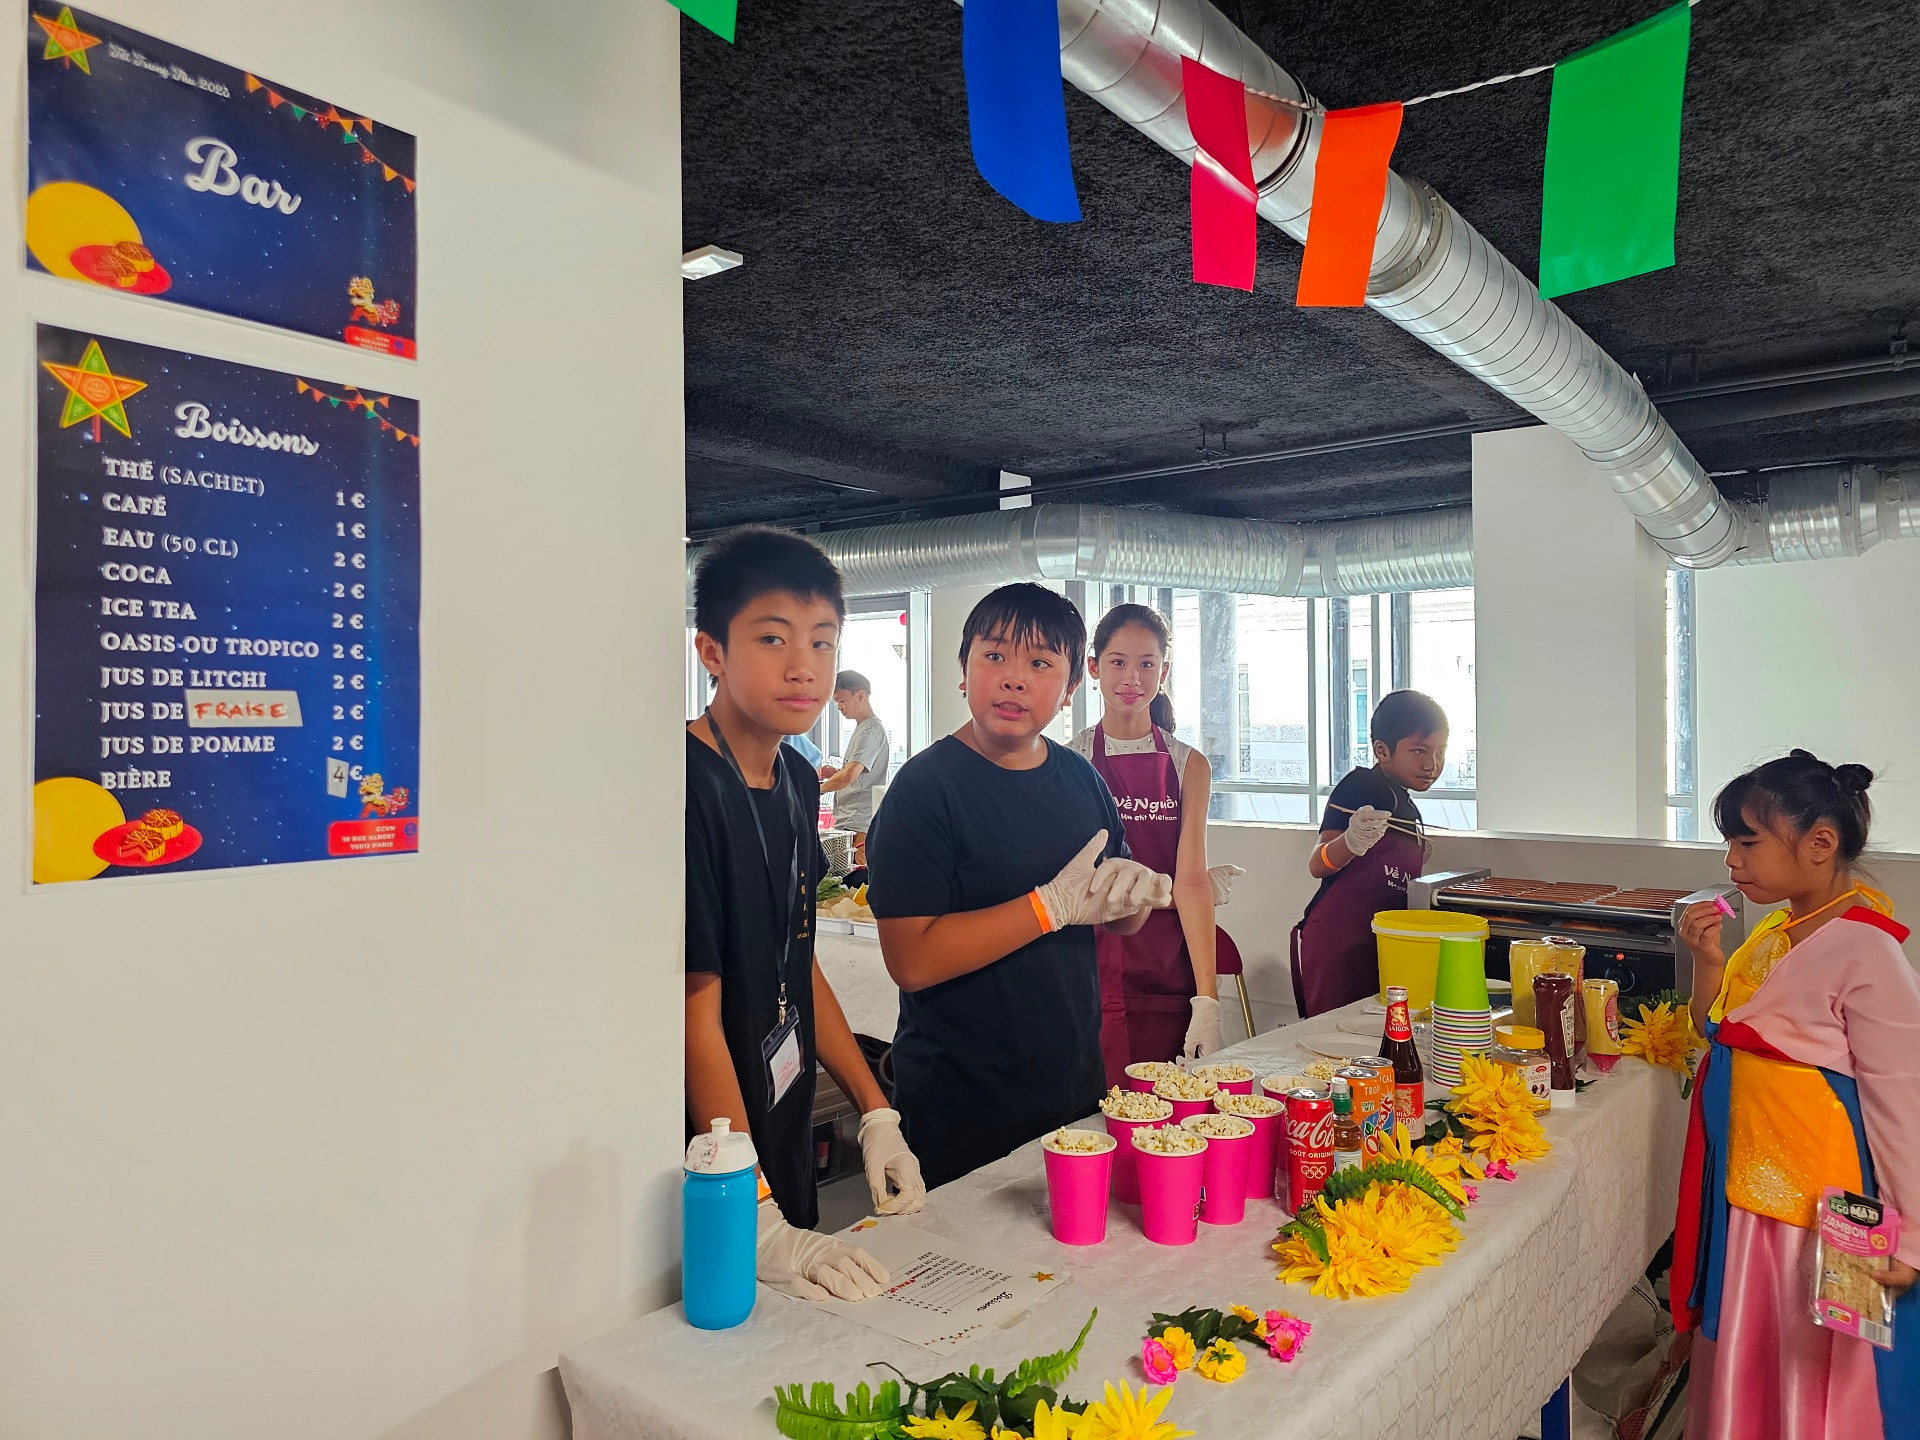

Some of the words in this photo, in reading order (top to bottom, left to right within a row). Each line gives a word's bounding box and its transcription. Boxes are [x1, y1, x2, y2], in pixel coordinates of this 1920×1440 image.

[197, 75, 231, 98] 2023
[184, 136, 302, 215] Bar
[174, 400, 320, 457] Boissons
[102, 455, 155, 482] THÉ
[159, 464, 266, 498] (SACHET)
[334, 492, 345, 507] 1
[350, 491, 366, 509] €
[102, 491, 168, 518] CAFÉ
[334, 522, 345, 538] 1
[350, 521, 366, 540] €
[101, 526, 155, 551] EAU
[160, 532, 198, 554] (50
[203, 537, 240, 560] CL)
[332, 551, 346, 569] 2
[350, 551, 366, 570] €
[101, 561, 173, 586] COCA
[332, 581, 346, 599] 2
[350, 581, 366, 601] €
[100, 596, 144, 618] ICE
[148, 598, 198, 621] TEA
[331, 612, 345, 629] 2
[348, 612, 365, 631] €
[100, 632, 177, 654] OASIS
[183, 635, 219, 656] OU
[224, 636, 320, 659] TROPICO
[331, 643, 345, 661] 2
[348, 643, 365, 661] €
[100, 665, 146, 690] JUS
[150, 667, 185, 688] DE
[190, 669, 268, 689] LITCHI
[331, 674, 345, 691] 2
[348, 673, 365, 691] €
[100, 700, 146, 724] JUS
[151, 701, 185, 721] DE
[331, 704, 345, 721] 2
[348, 704, 365, 722] €
[100, 735, 146, 759] JUS
[151, 735, 185, 755] DE
[190, 735, 276, 754] POMME
[331, 735, 345, 752] 2
[348, 735, 365, 752] €
[100, 767, 173, 791] BIÈRE
[333, 766, 345, 783] 4
[349, 765, 363, 781] €
[368, 833, 397, 841] ALBERT
[371, 841, 394, 849] PARIS
[1397, 1117, 1418, 1125] IGON
[1308, 1150, 1334, 1159] ORIGINA
[1850, 1205, 1880, 1222] MAXI
[1822, 1215, 1869, 1240] JAMBON
[904, 1264, 924, 1276] POMME
[920, 1275, 944, 1289] TROPICO
[969, 1267, 984, 1276] COCA
[976, 1291, 1013, 1312] Boissons
